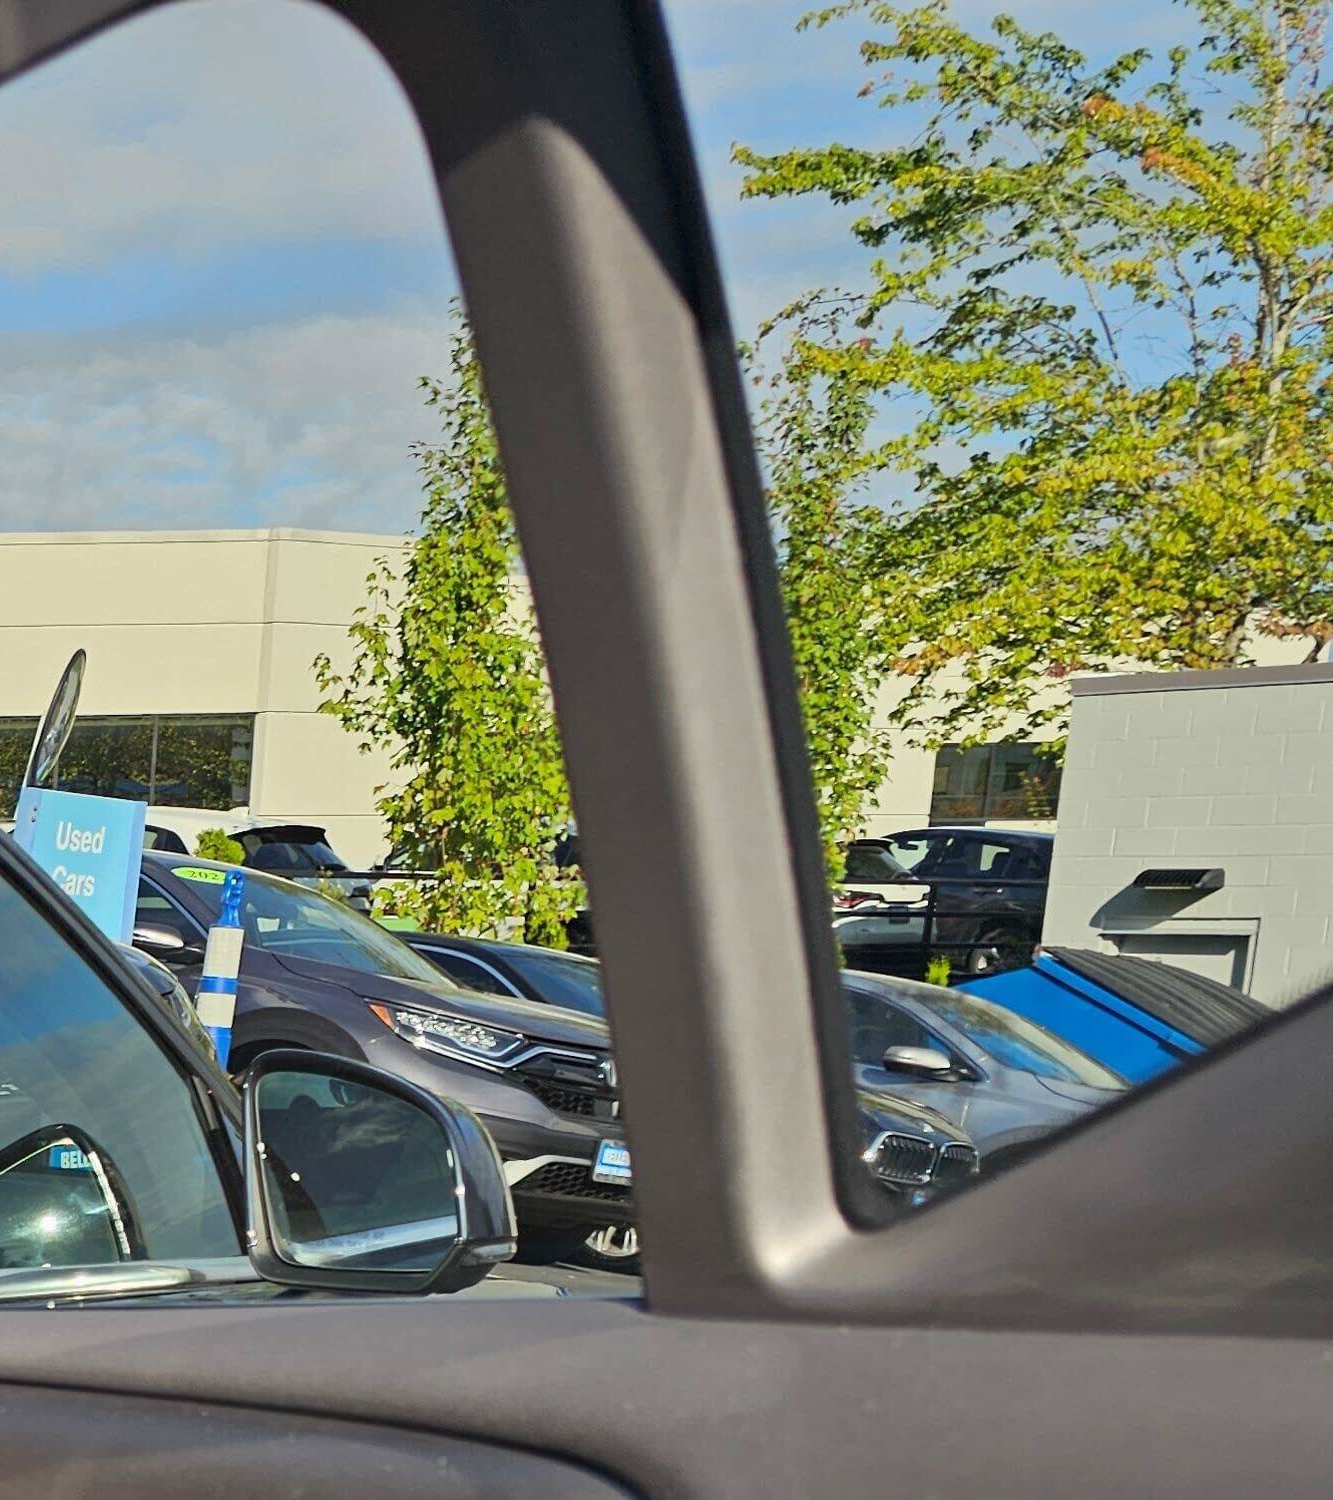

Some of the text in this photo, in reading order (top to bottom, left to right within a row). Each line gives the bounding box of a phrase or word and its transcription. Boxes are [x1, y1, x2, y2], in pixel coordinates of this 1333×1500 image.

[55, 821, 106, 854] Used
[51, 865, 95, 896] Cars
[188, 869, 220, 881] 202
